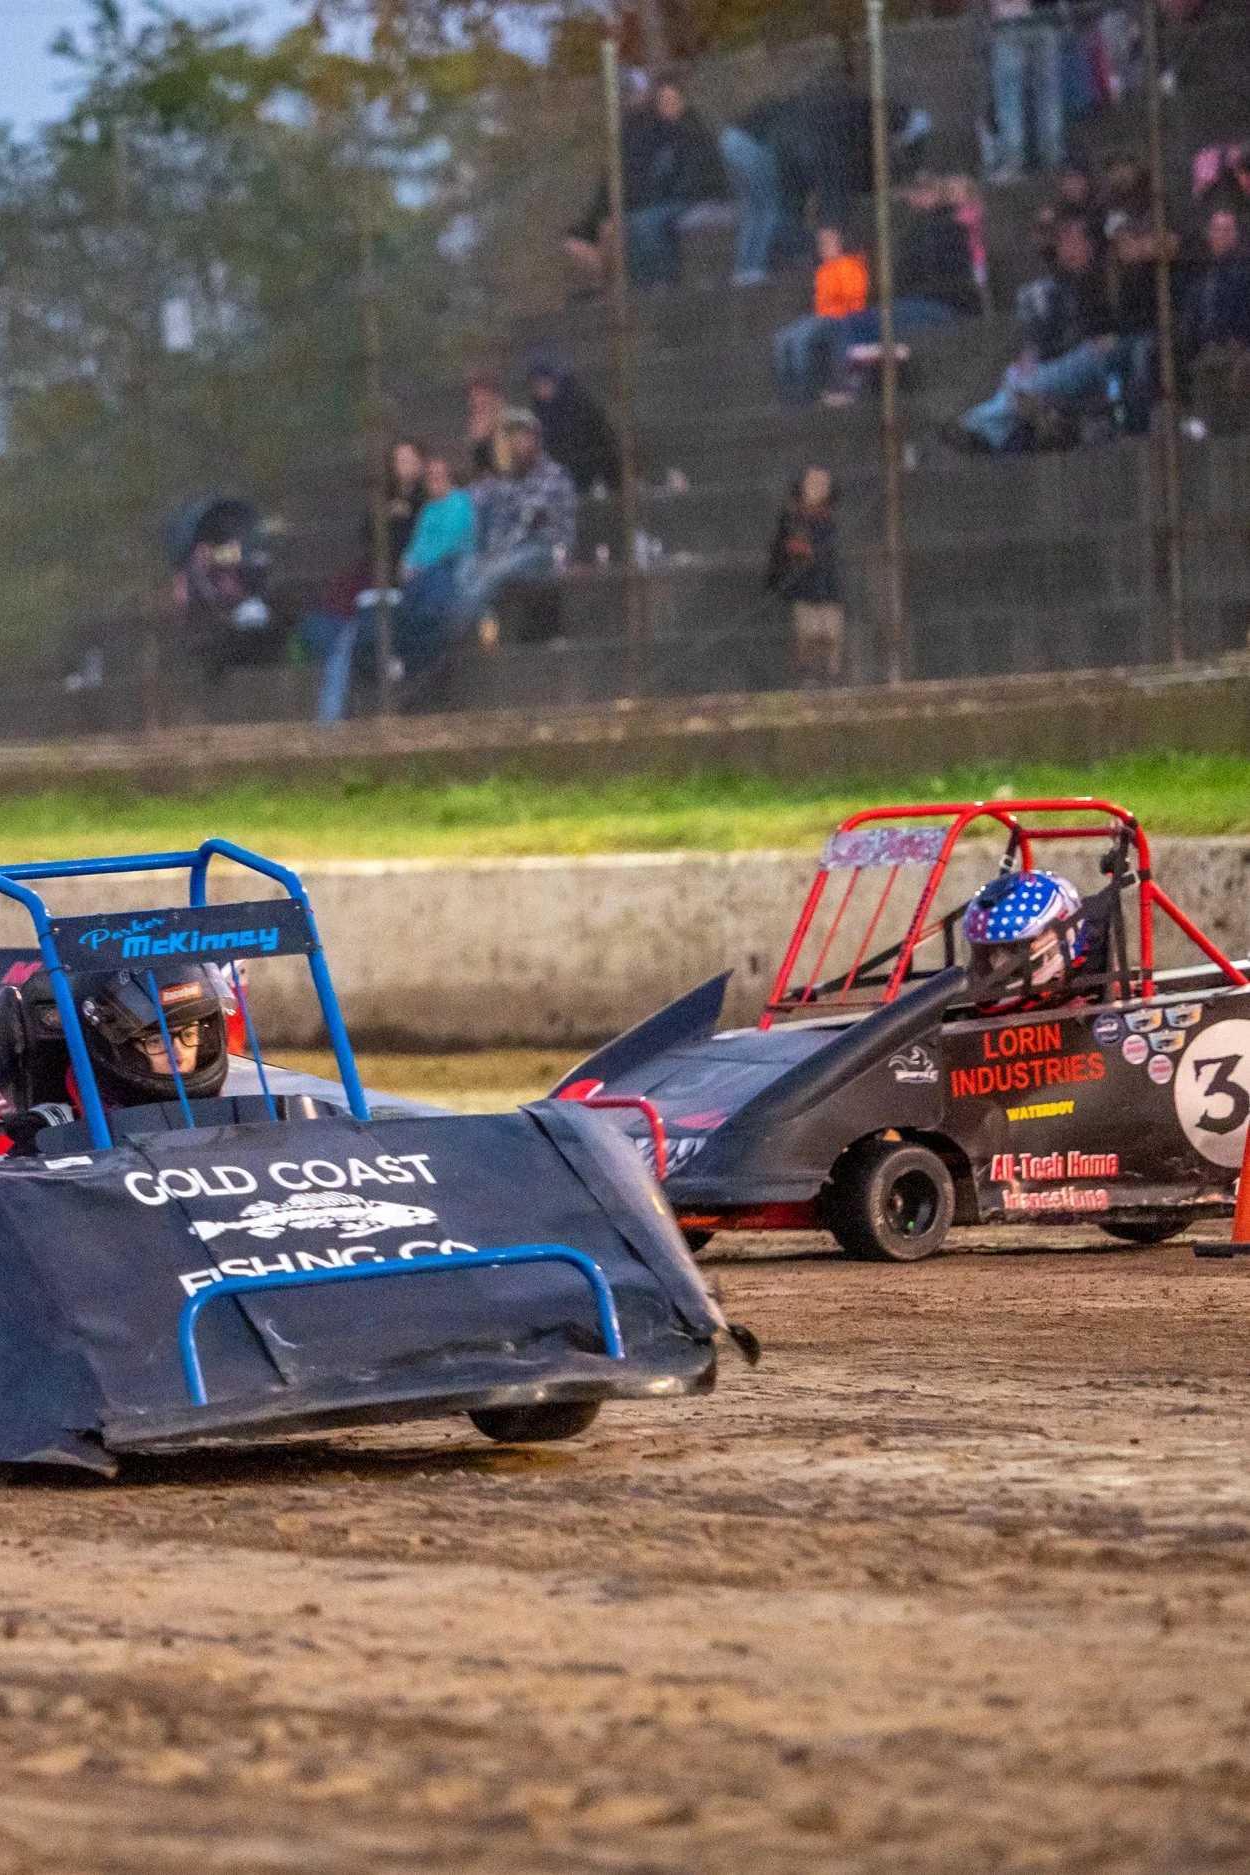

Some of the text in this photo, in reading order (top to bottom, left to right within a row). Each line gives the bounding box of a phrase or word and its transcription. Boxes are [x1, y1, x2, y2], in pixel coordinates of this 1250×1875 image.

[78, 917, 165, 950] Parker
[122, 927, 279, 959] McKinney
[983, 1023, 1061, 1060] LORIN
[951, 1052, 1106, 1097] INDUSTRIES
[1006, 1100, 1075, 1121] WATERBOY
[1193, 1054, 1250, 1135] 3
[124, 1154, 437, 1206] GOLD COAST
[1067, 1150, 1119, 1178] Home
